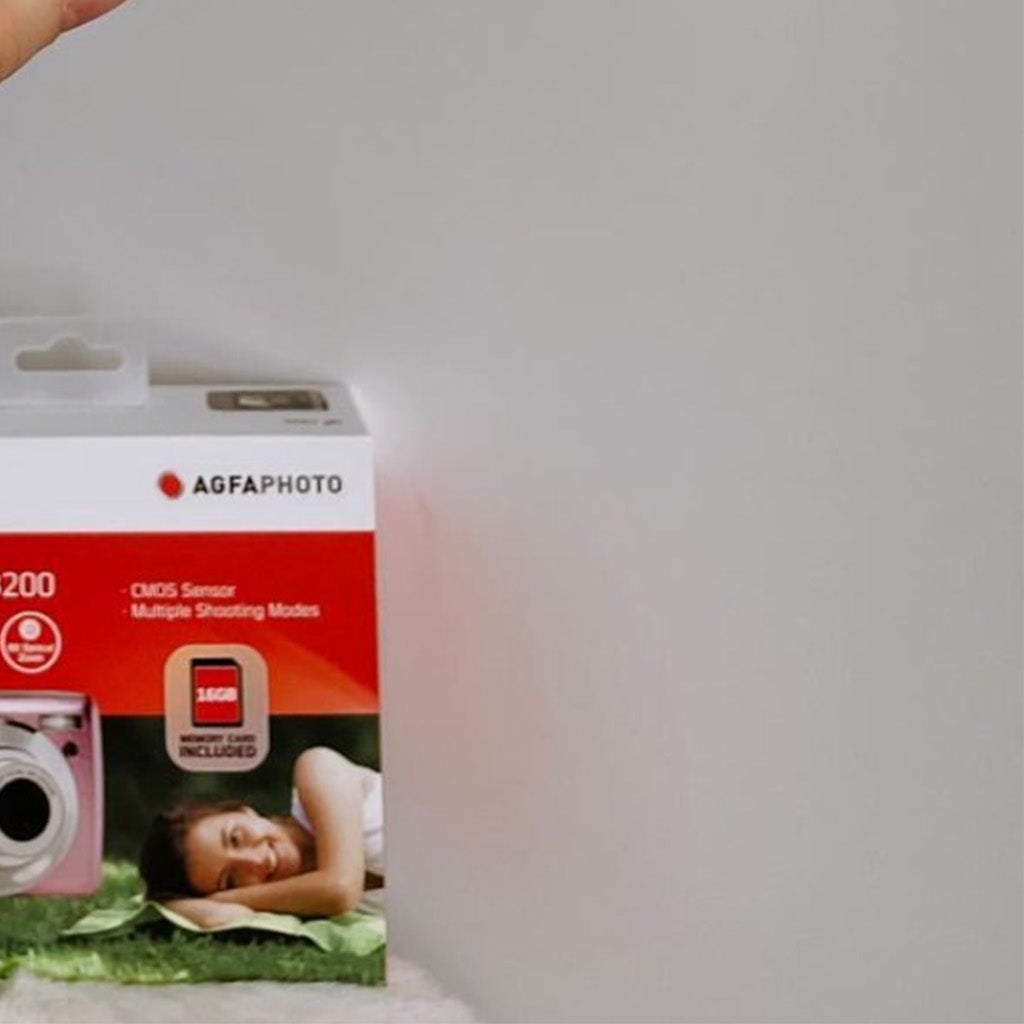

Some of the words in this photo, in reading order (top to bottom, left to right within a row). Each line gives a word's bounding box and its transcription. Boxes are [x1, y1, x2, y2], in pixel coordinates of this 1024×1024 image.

[193, 475, 343, 495] AGFAPHOTO
[130, 582, 178, 598] CMOS
[180, 581, 237, 598] Sensor
[130, 603, 192, 621] Multiple
[194, 602, 266, 621] Shooting
[268, 602, 321, 618] Modes
[179, 745, 257, 759] INCLUDED
